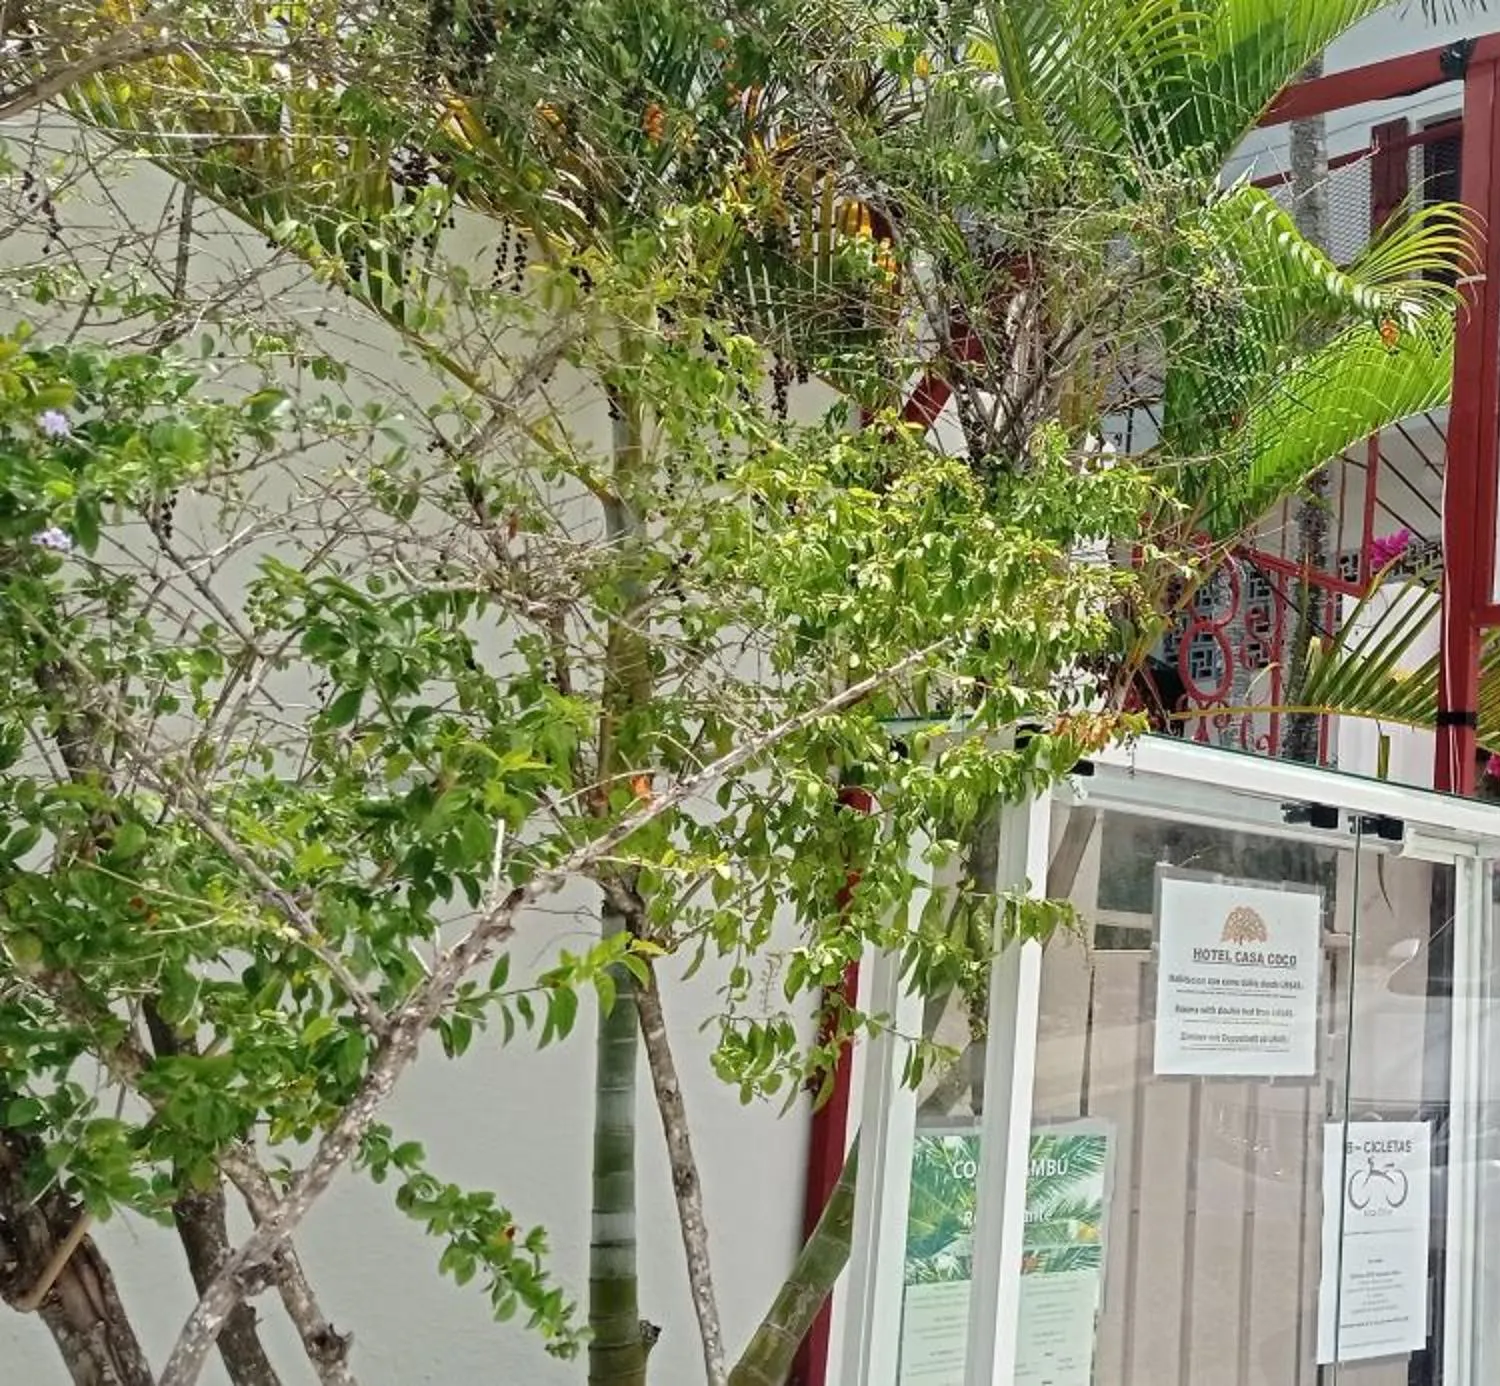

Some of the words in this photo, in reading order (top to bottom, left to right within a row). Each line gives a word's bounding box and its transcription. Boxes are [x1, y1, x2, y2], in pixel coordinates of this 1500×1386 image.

[1193, 948, 1231, 960] HOTEL
[1235, 951, 1265, 963] CASA
[1267, 953, 1297, 966] COCO
